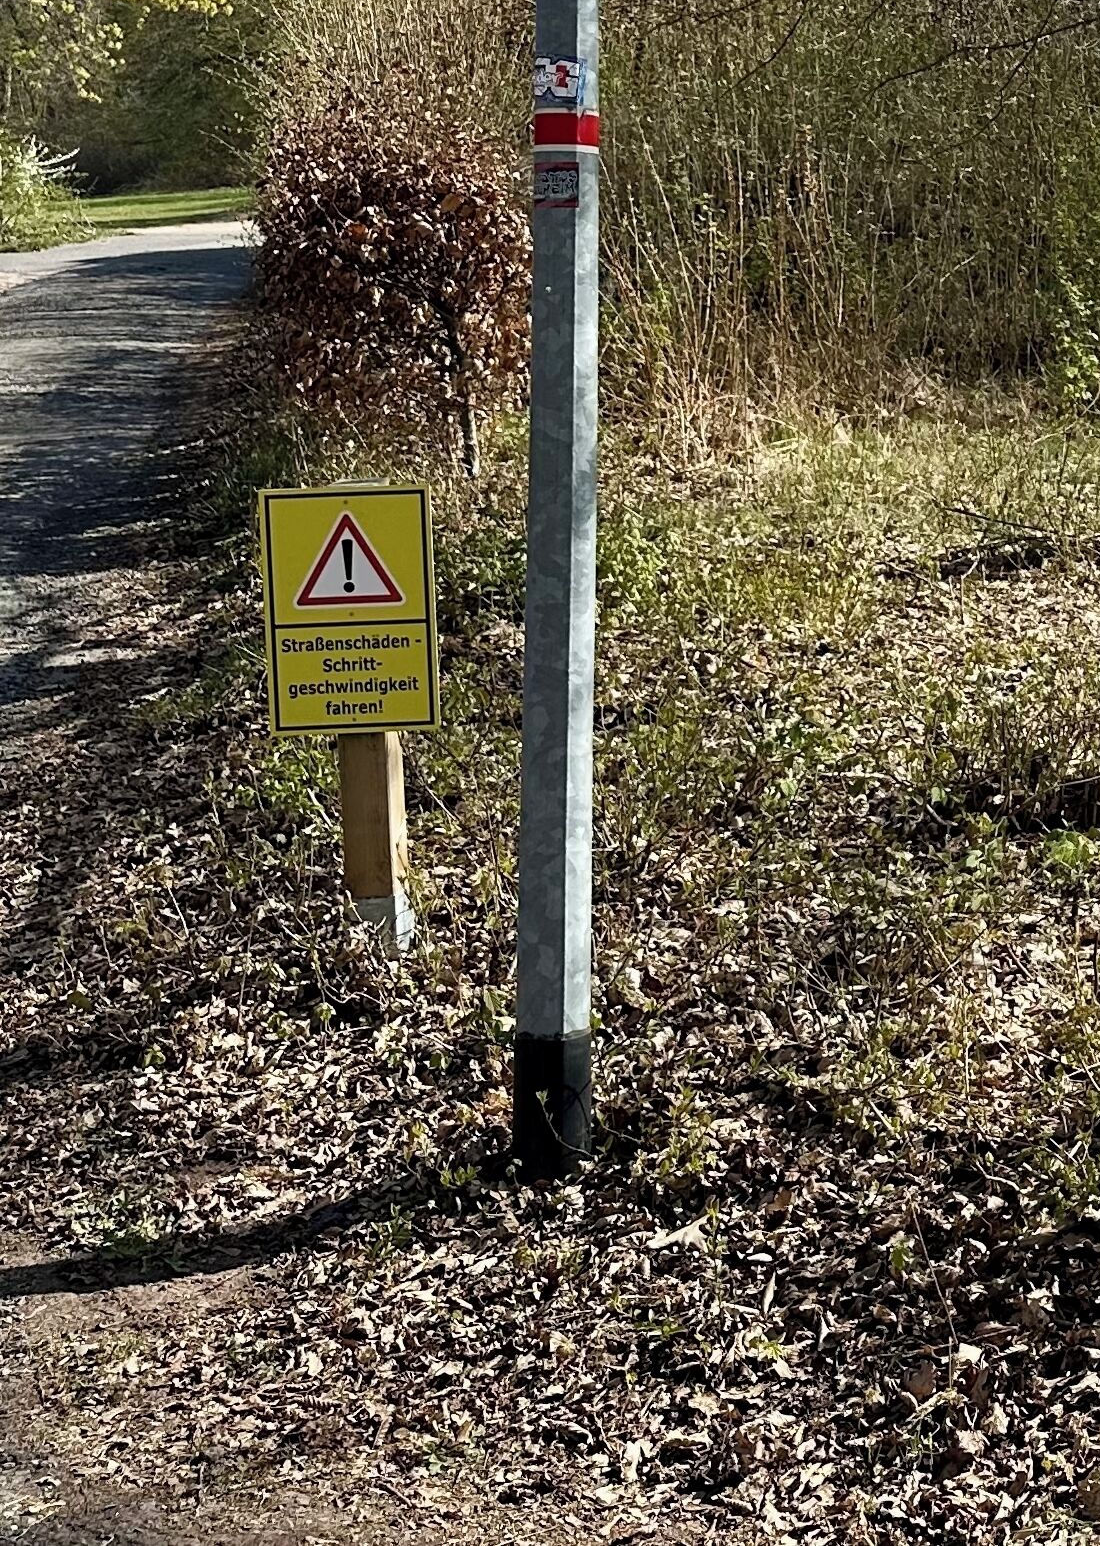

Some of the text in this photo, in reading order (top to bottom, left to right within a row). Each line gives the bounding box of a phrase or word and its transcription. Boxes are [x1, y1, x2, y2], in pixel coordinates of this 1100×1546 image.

[281, 634, 410, 653] Straßenschäden
[322, 656, 383, 673] Schritt-
[288, 676, 419, 699] geschwindigkeit
[325, 700, 384, 716] fahren!
